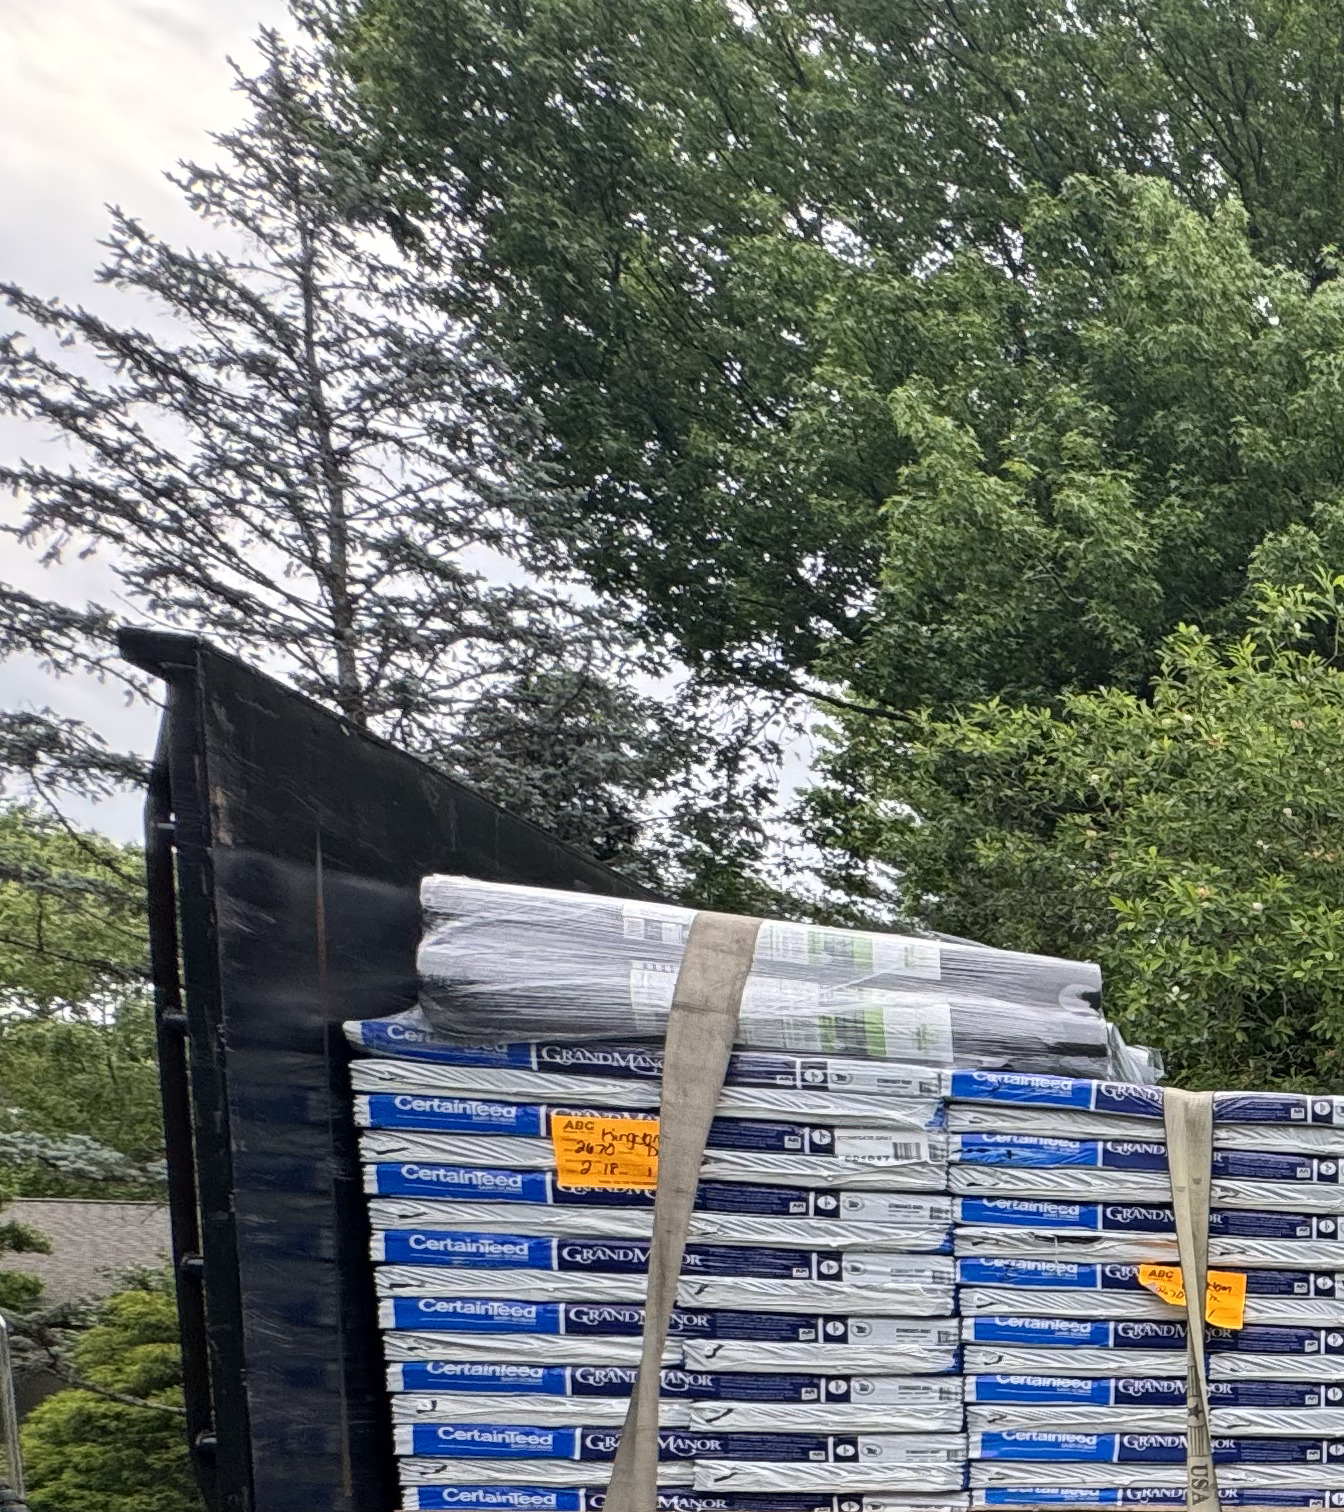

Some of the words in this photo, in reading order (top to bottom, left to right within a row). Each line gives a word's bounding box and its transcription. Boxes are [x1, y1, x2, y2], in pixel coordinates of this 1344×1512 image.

[395, 1095, 517, 1119] CertainTeed
[563, 1120, 595, 1130] ABC
[401, 1165, 523, 1188] CertainTeed
[409, 1235, 529, 1256] CertainTeed
[1148, 1269, 1175, 1279] ABC
[418, 1299, 537, 1318] CertainTeed
[426, 1361, 543, 1378] CertainTeed
[437, 1426, 553, 1446] CertainTeed
[1190, 1463, 1211, 1506] USA
[442, 1489, 557, 1505] CertainTeed
